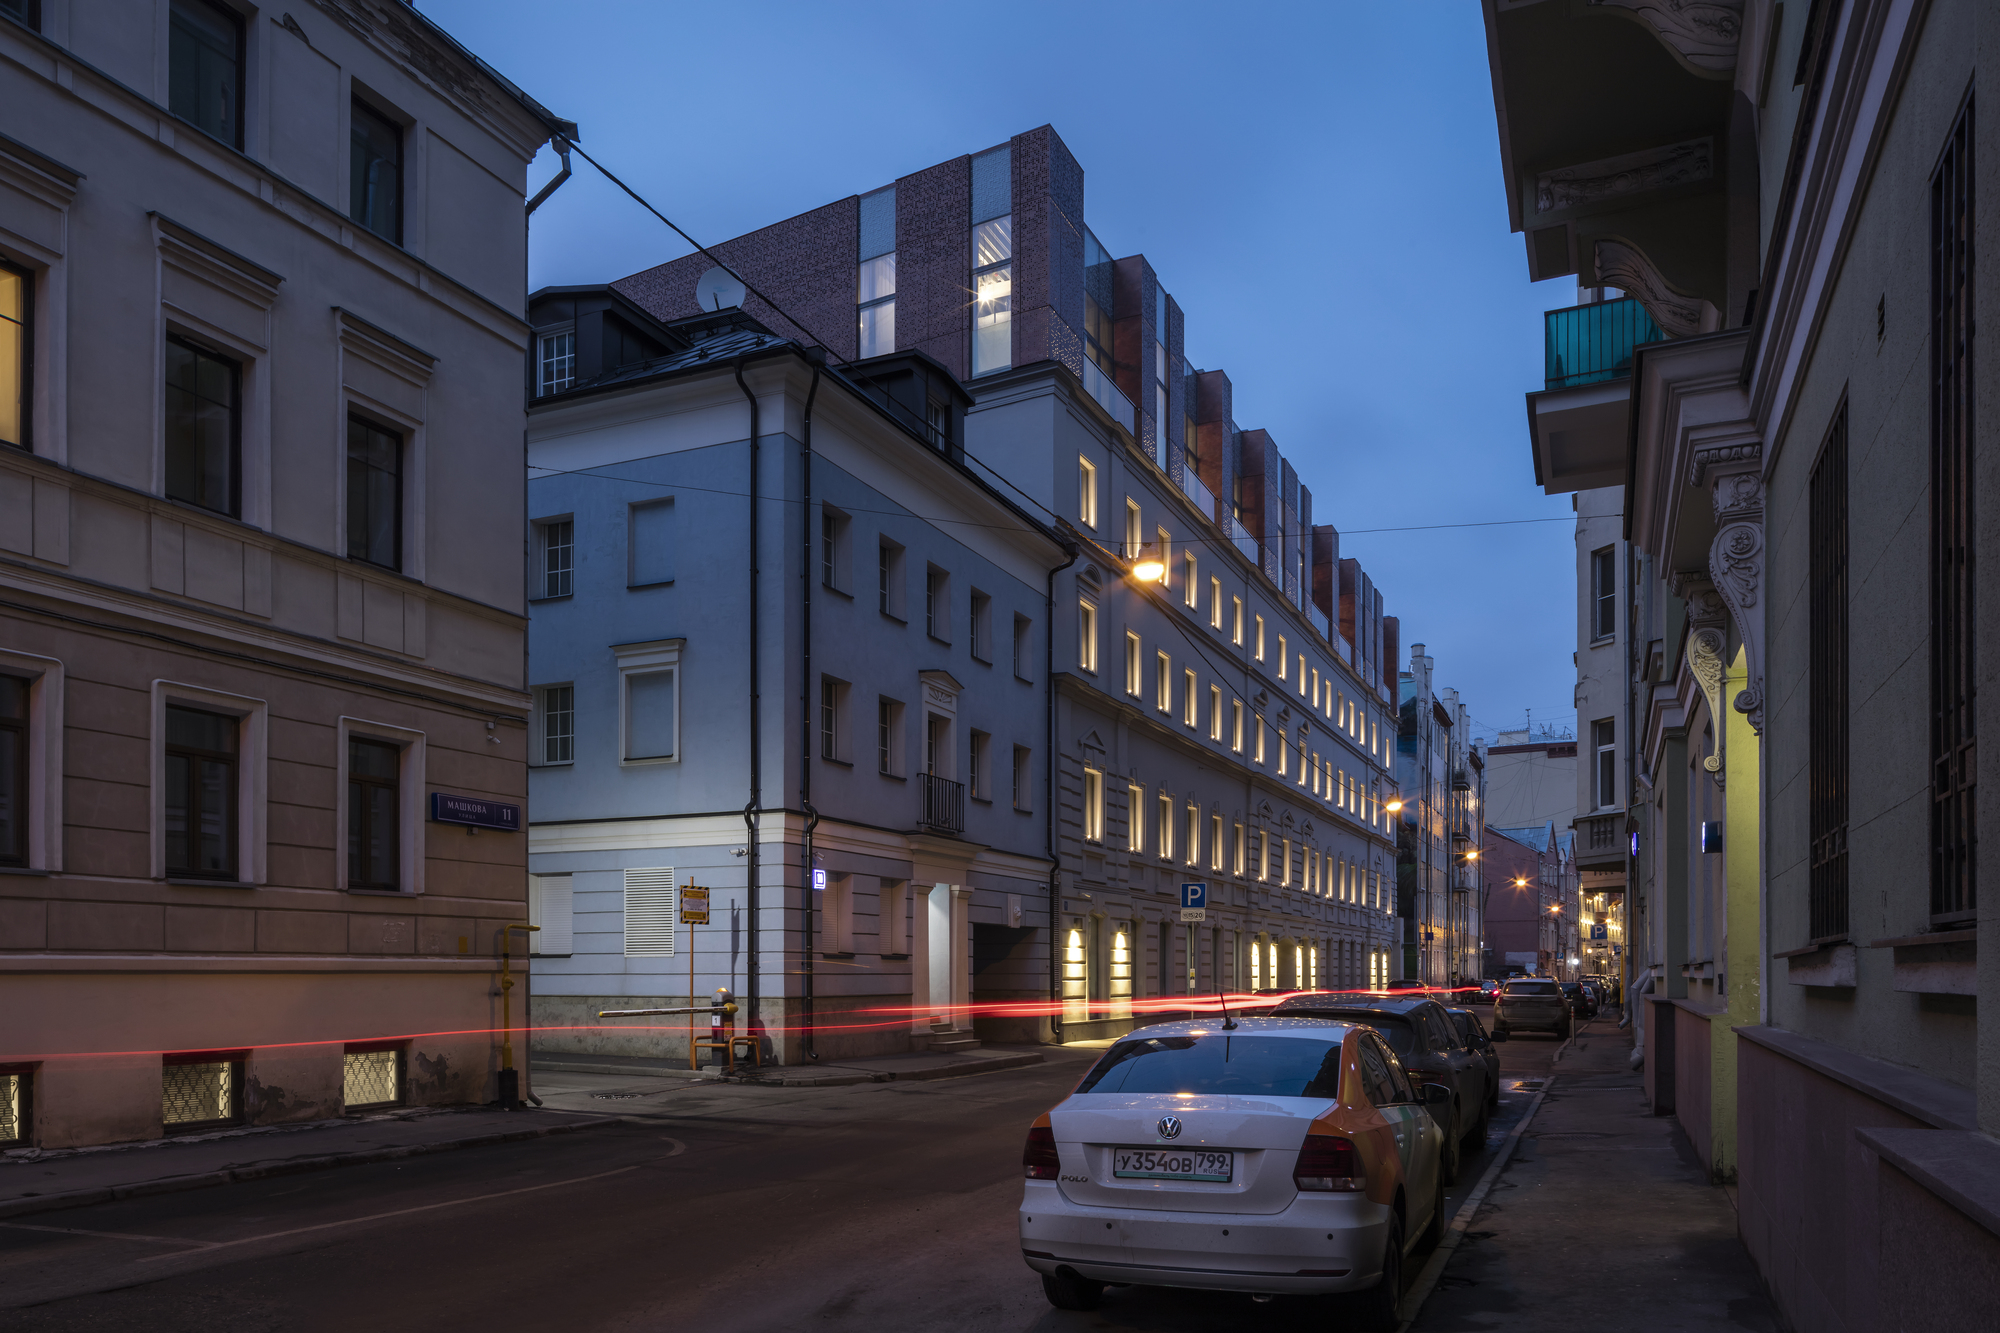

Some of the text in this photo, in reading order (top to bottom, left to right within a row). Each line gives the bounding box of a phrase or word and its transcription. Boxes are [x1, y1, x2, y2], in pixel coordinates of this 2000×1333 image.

[447, 800, 511, 821] МАШКОВА 11
[458, 812, 476, 820] УЛИЦА
[1187, 885, 1202, 906] P
[1594, 925, 1604, 938] P
[1197, 1153, 1226, 1169] 799
[1061, 1174, 1088, 1183] POLO
